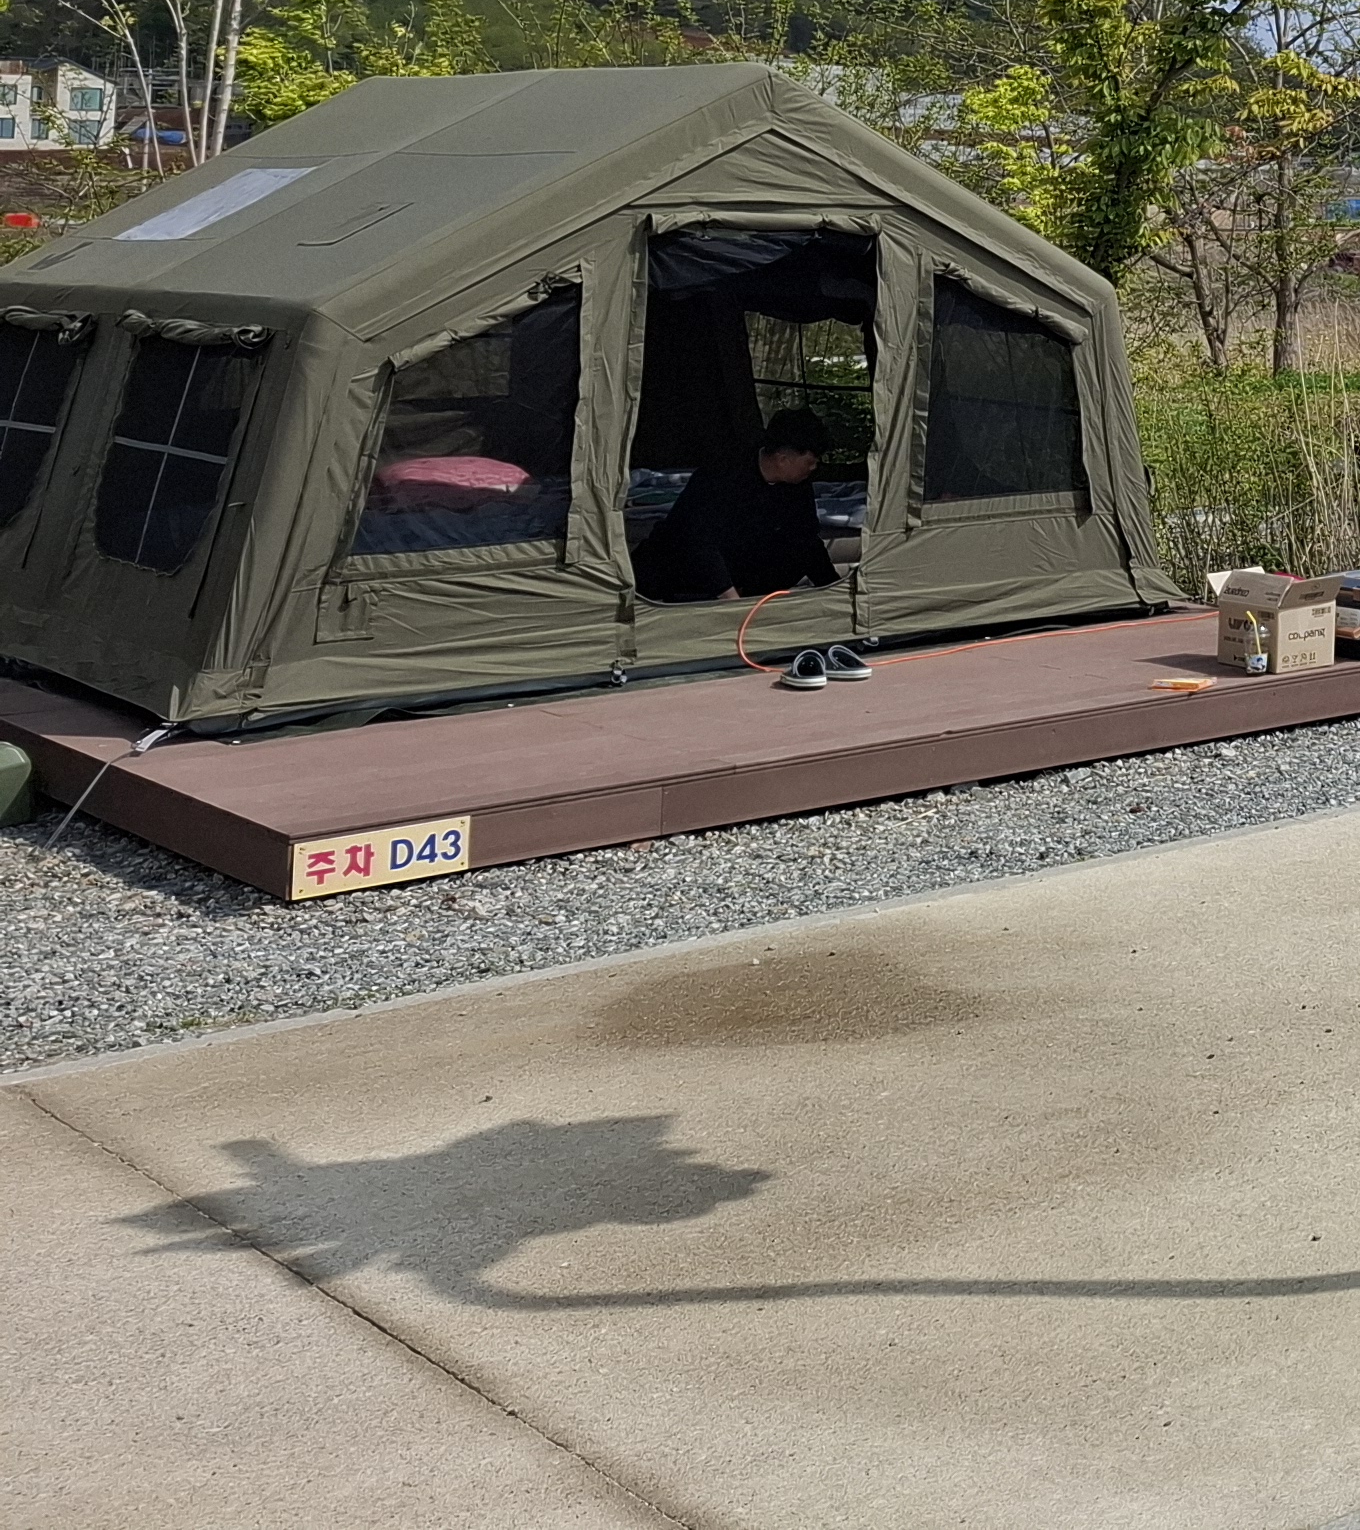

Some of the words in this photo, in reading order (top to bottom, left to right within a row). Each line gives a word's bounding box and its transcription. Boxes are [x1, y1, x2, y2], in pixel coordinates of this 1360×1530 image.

[1288, 628, 1326, 641] coupang
[305, 844, 375, 886] 주차
[390, 829, 462, 871] D43
